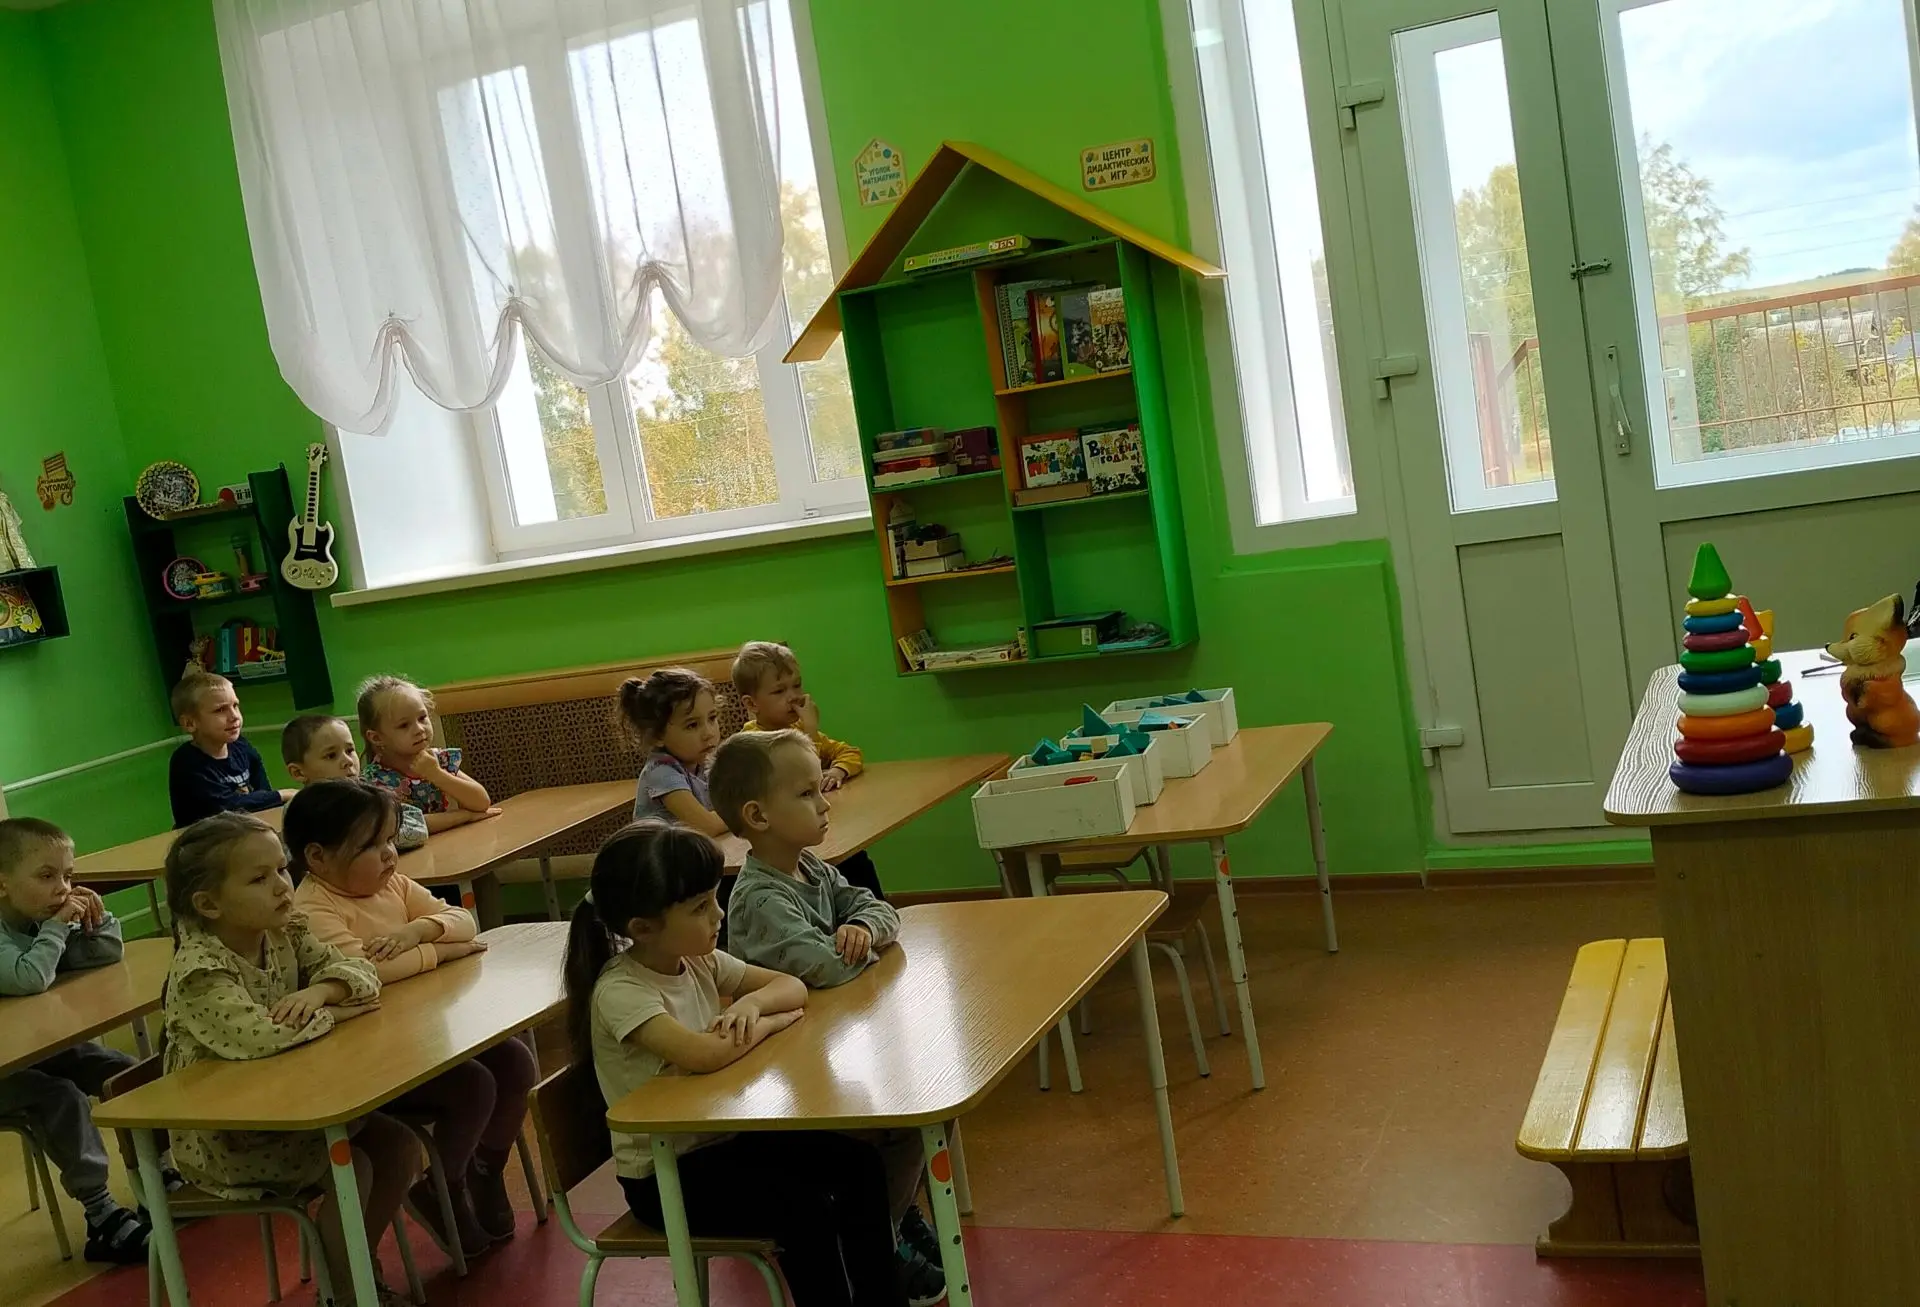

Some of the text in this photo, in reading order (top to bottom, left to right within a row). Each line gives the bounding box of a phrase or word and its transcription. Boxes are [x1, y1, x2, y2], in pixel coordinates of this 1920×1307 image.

[1102, 147, 1132, 161] ЦЕНТР
[1086, 155, 1150, 175] ДИДАКТИЧЕСКИХ
[1110, 169, 1128, 181] ИГР
